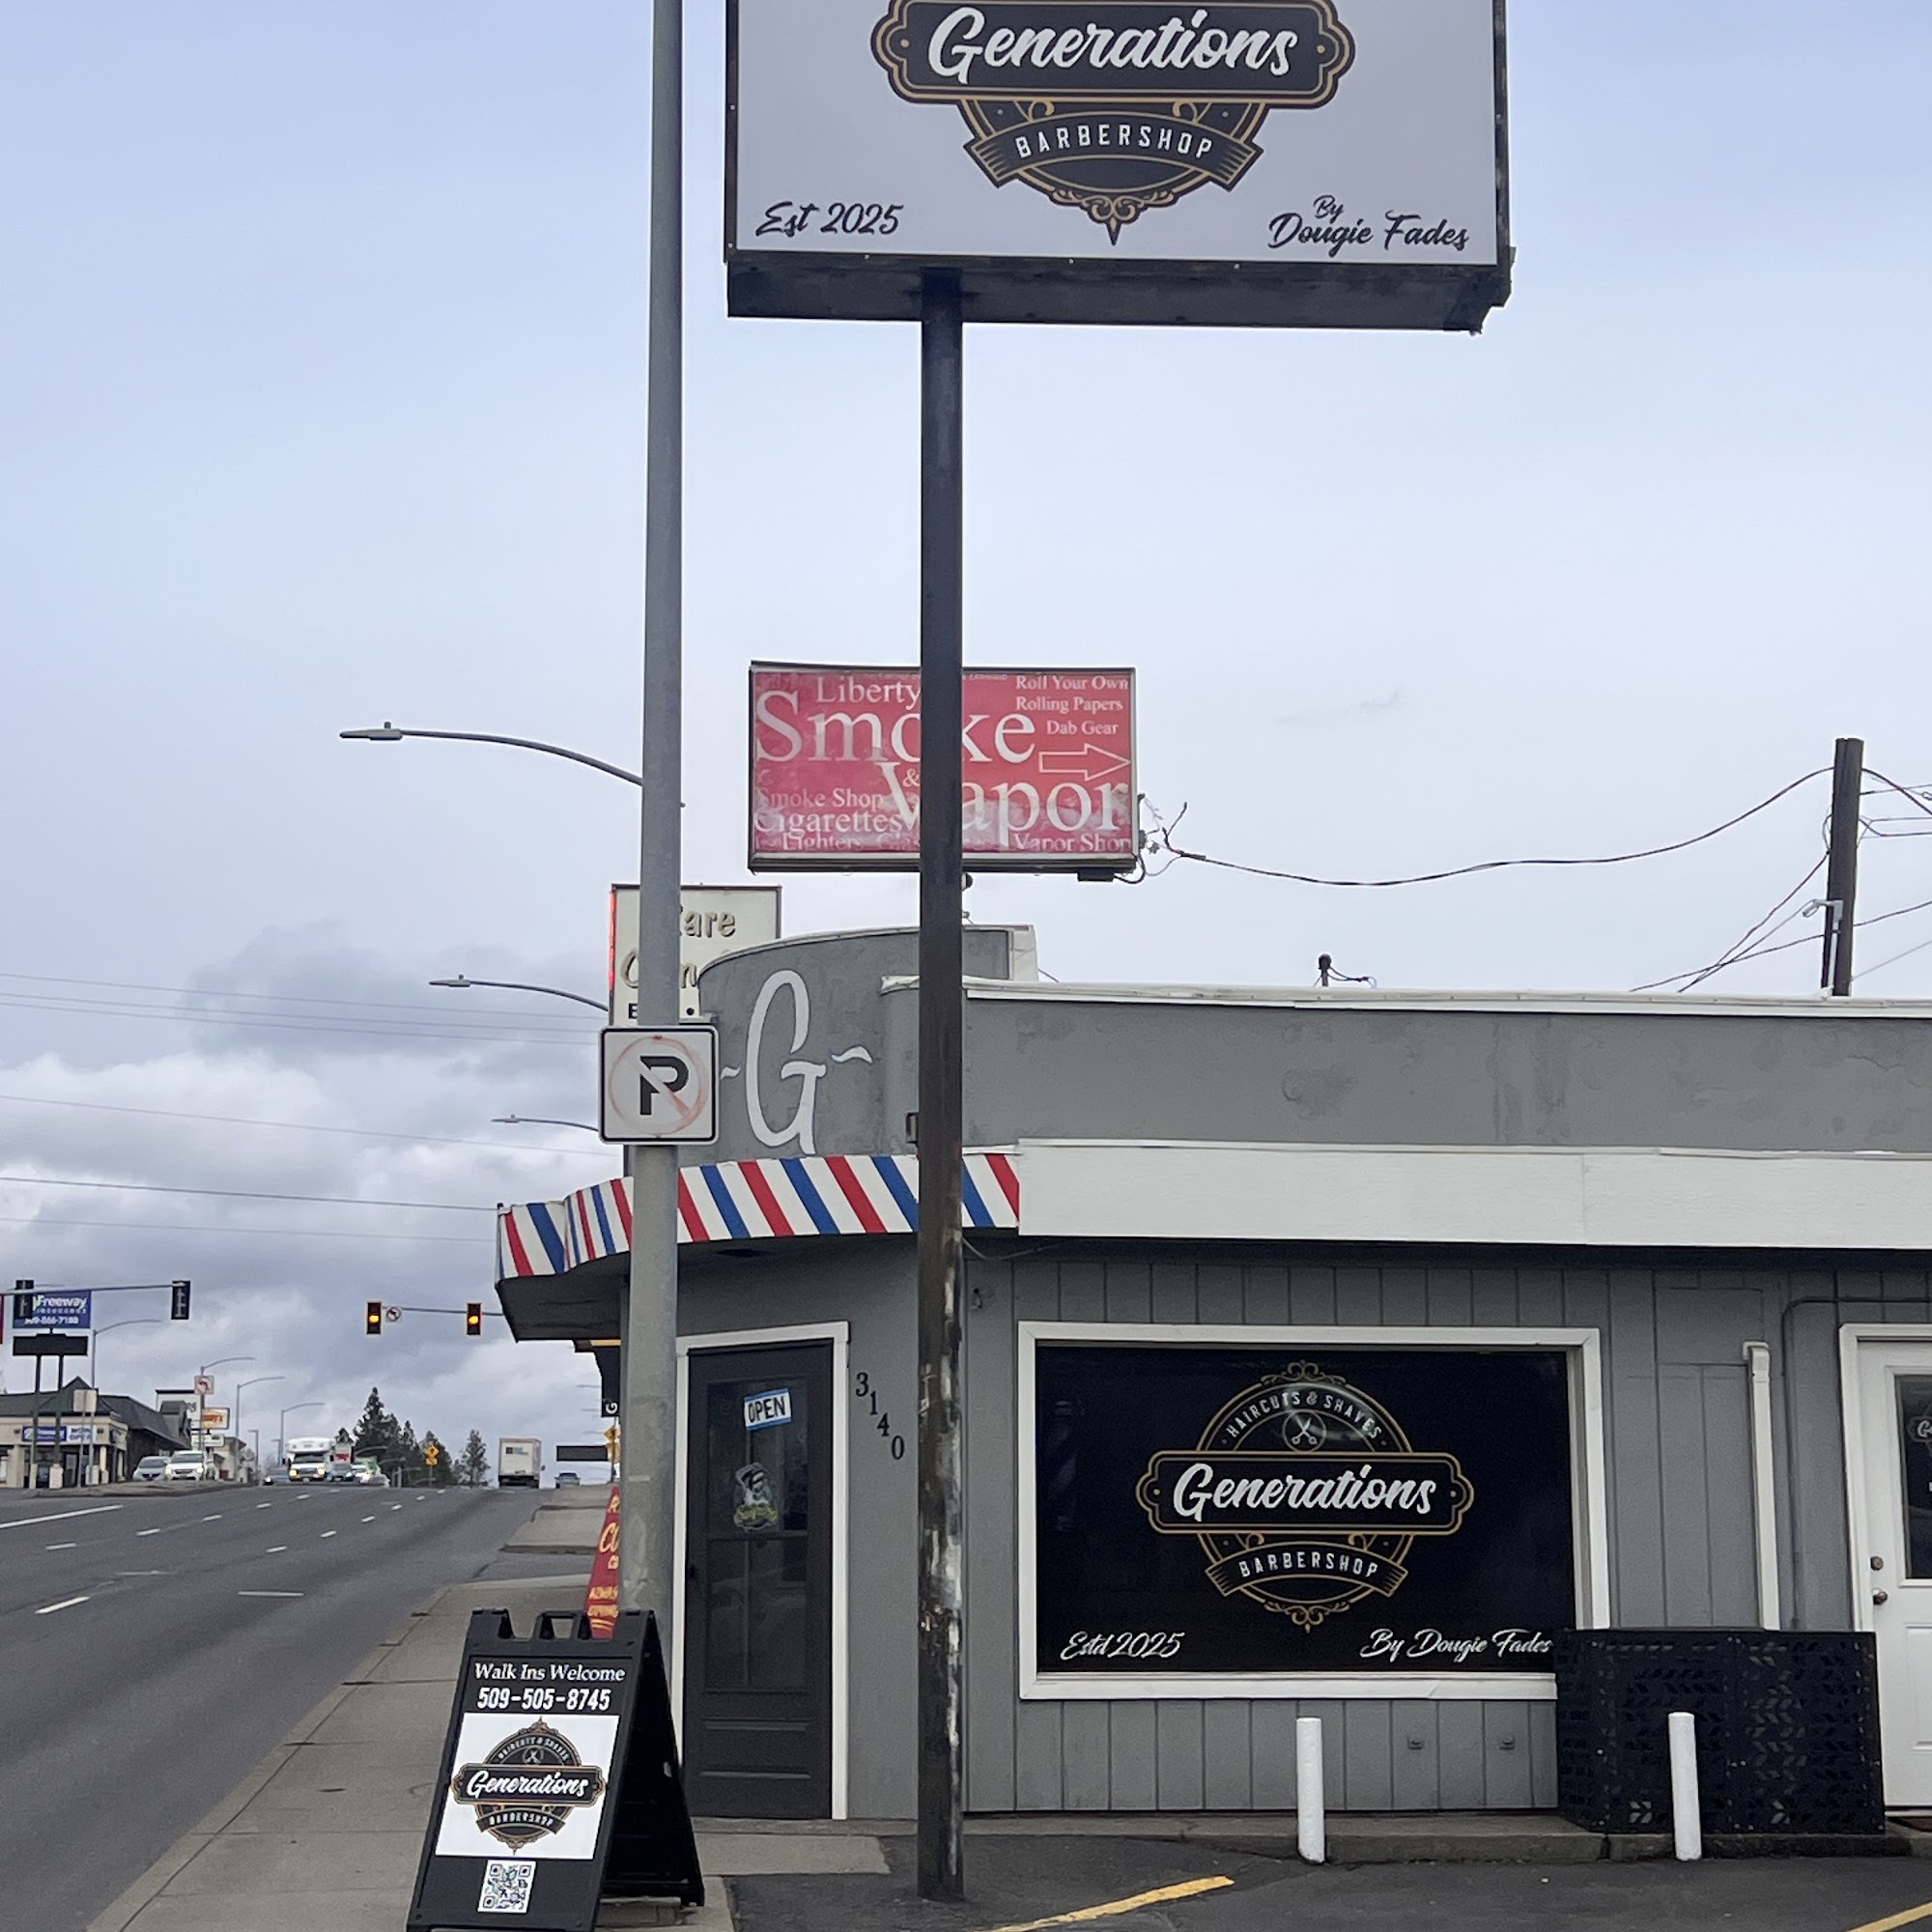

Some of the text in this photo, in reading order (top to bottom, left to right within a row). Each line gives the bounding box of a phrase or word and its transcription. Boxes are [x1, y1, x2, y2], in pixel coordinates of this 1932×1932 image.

[927, 6, 1298, 83] Generations
[1013, 122, 1214, 159] BARBERSHOP
[755, 201, 904, 240] Est 2025
[1313, 195, 1344, 223] By
[1267, 211, 1469, 259] Dougie Fades
[817, 676, 922, 711] Liberty
[1016, 675, 1048, 690] Roll
[1052, 675, 1087, 690] Your
[1092, 676, 1129, 691] Own
[1016, 696, 1123, 715] Rolling Papers
[1046, 721, 1119, 735] Dab Gear
[832, 787, 883, 812] Shop
[679, 904, 736, 938] are
[747, 1396, 785, 1424] OPEN
[1225, 1391, 1302, 1440] HAIRCUTS
[1321, 1392, 1382, 1440] SHAVES
[1173, 1463, 1436, 1522] Generations
[1238, 1550, 1378, 1578] BARBERSHOP
[1359, 1629, 1553, 1662] By Dougie Fades
[474, 1662, 626, 1682] Walk Ins Welcome
[477, 1687, 611, 1711] 509-505-8745
[467, 1770, 589, 1799] Generations
